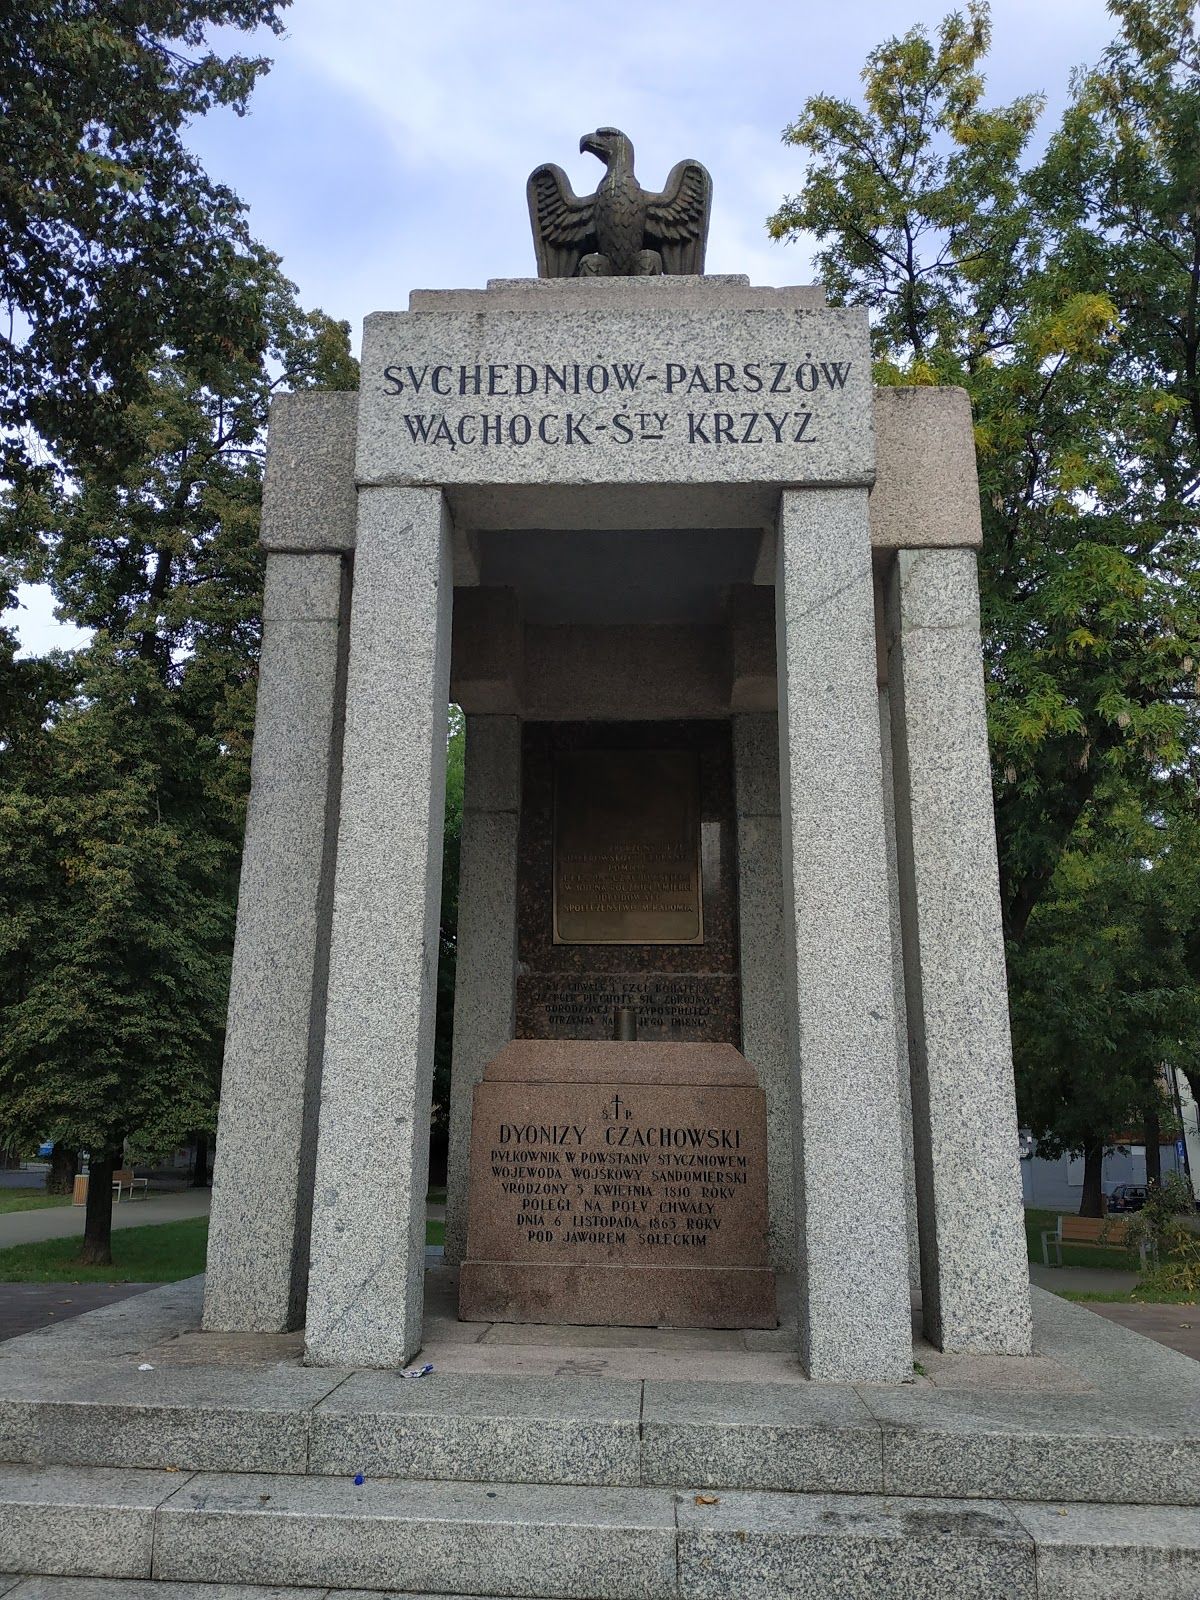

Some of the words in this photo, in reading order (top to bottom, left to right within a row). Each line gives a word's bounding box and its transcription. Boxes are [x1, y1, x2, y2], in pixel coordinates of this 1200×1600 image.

[687, 403, 817, 444] KRZYŻ
[499, 1124, 588, 1145] DYONIZY
[605, 1126, 743, 1148] CZACHOWSKI
[565, 1151, 575, 1163] W
[581, 1152, 650, 1165] POWSTANIV
[658, 1154, 747, 1167] STYCZNIOWEM
[492, 1166, 562, 1179] WOJEWODA
[572, 1168, 642, 1180] WOJSKOWY
[652, 1171, 747, 1184] SANDOMIERSKI
[577, 1184, 584, 1195] 5
[594, 1185, 652, 1197] KWIETNIA
[664, 1187, 691, 1198] 1810
[702, 1187, 736, 1199] ROKV
[584, 1200, 602, 1212] NA
[517, 1214, 545, 1226] DNIA
[554, 1216, 561, 1226] 6
[573, 1216, 640, 1228] LISTOPADA
[649, 1218, 676, 1229] 1863
[686, 1218, 722, 1230] ROKV
[528, 1230, 553, 1242] POD
[563, 1232, 625, 1244] JAWOREM
